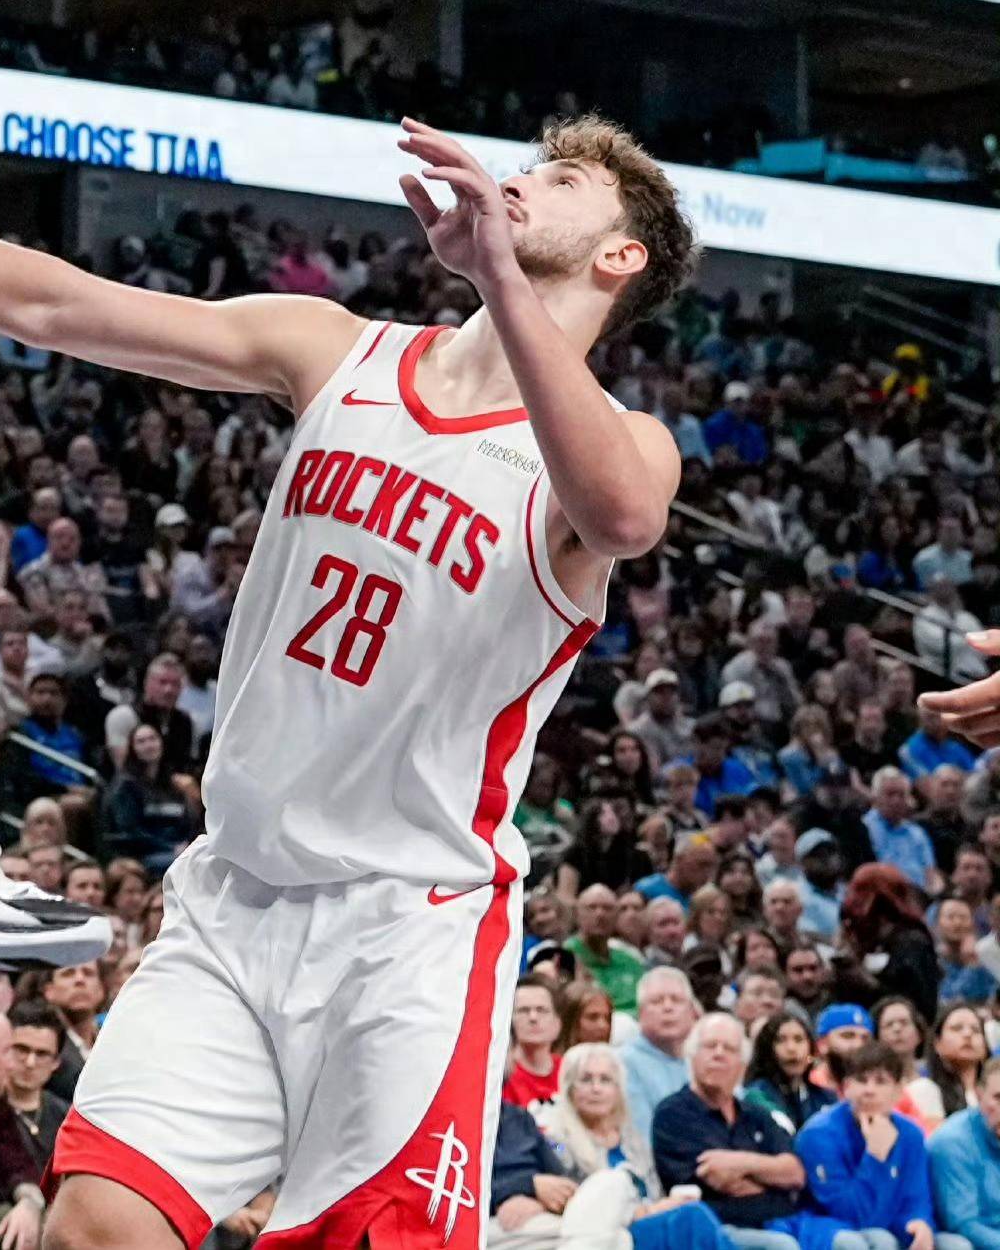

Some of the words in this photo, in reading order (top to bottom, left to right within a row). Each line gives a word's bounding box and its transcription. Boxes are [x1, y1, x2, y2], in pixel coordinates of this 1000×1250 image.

[3, 112, 136, 170] CHOOSE
[281, 449, 501, 595] ROCKETS
[284, 553, 403, 688] 28
